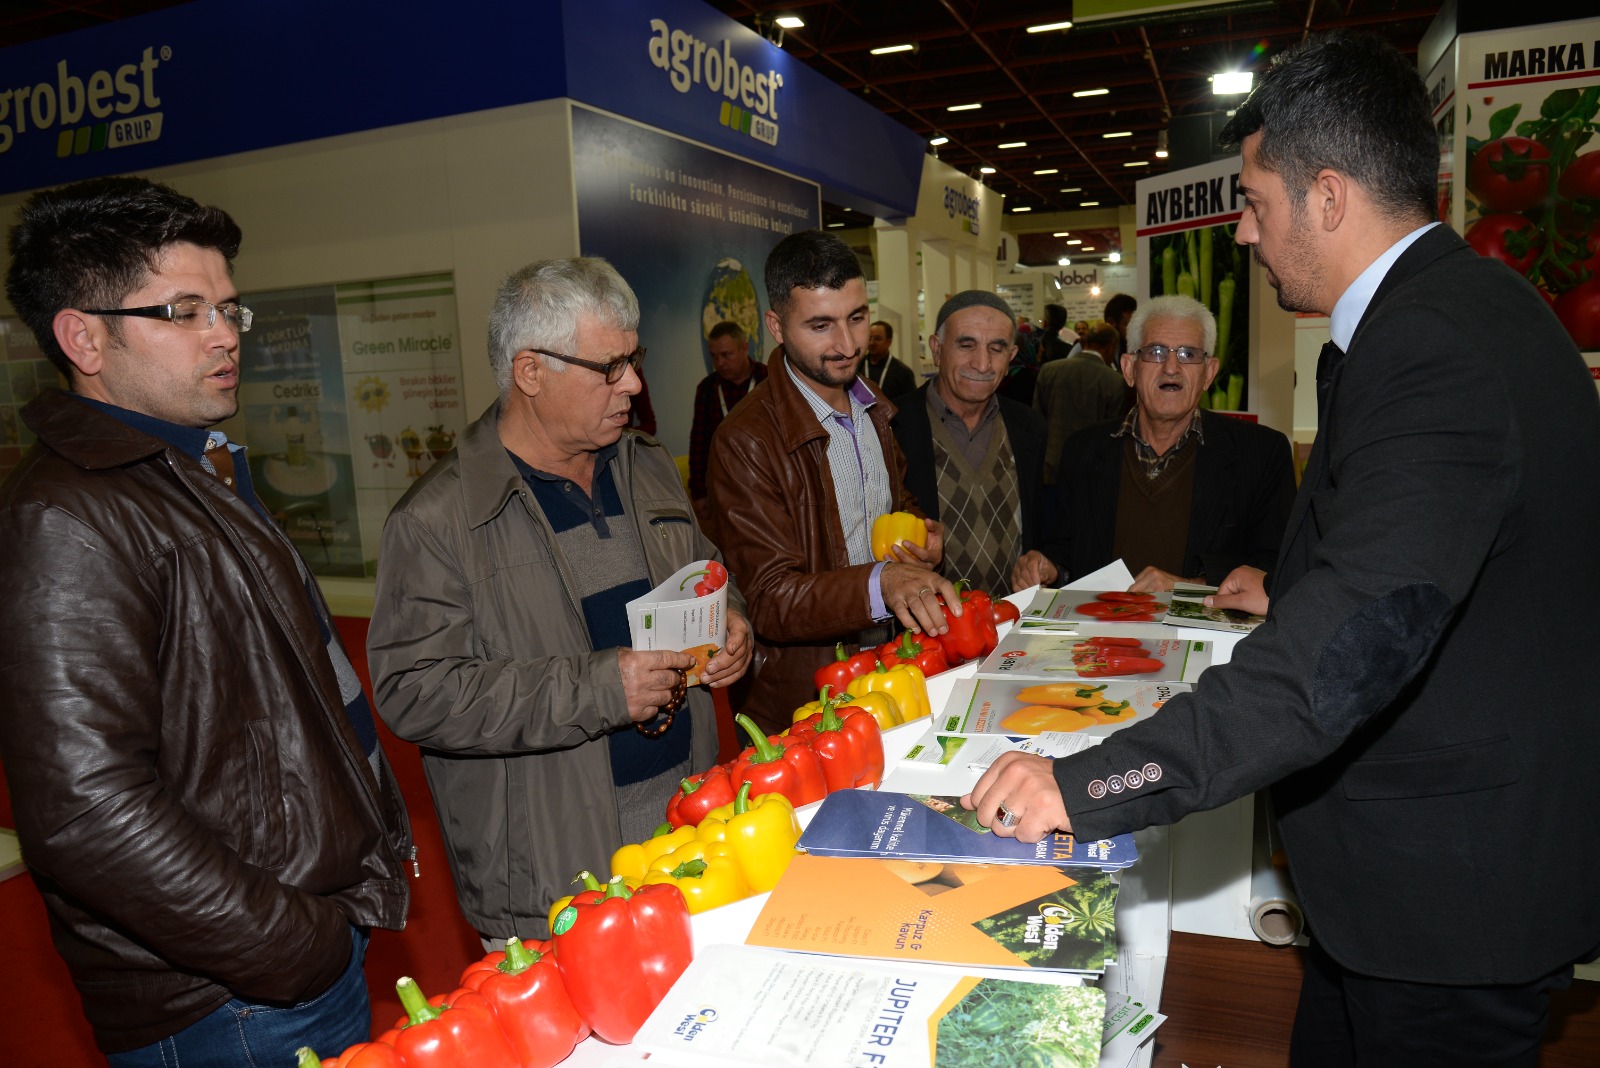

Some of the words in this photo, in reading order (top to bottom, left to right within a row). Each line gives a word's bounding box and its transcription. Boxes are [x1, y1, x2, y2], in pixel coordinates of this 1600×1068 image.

[649, 19, 778, 120] agrobest
[1484, 42, 1585, 80] MARKA
[115, 119, 152, 142] GRUP
[1146, 176, 1224, 226] AYBERK
[352, 340, 395, 356] Green
[398, 335, 452, 353] Miracle
[273, 383, 319, 399] Cedriks
[1052, 832, 1074, 860] ETTA
[895, 922, 911, 950] kavun
[911, 909, 933, 941] Karpuz
[1024, 915, 1042, 943] West
[1043, 906, 1069, 950] Golden
[674, 1014, 698, 1035] West
[683, 1008, 716, 1041] Golden
[867, 978, 917, 1046] JUPITER
[861, 1051, 886, 1068] F
